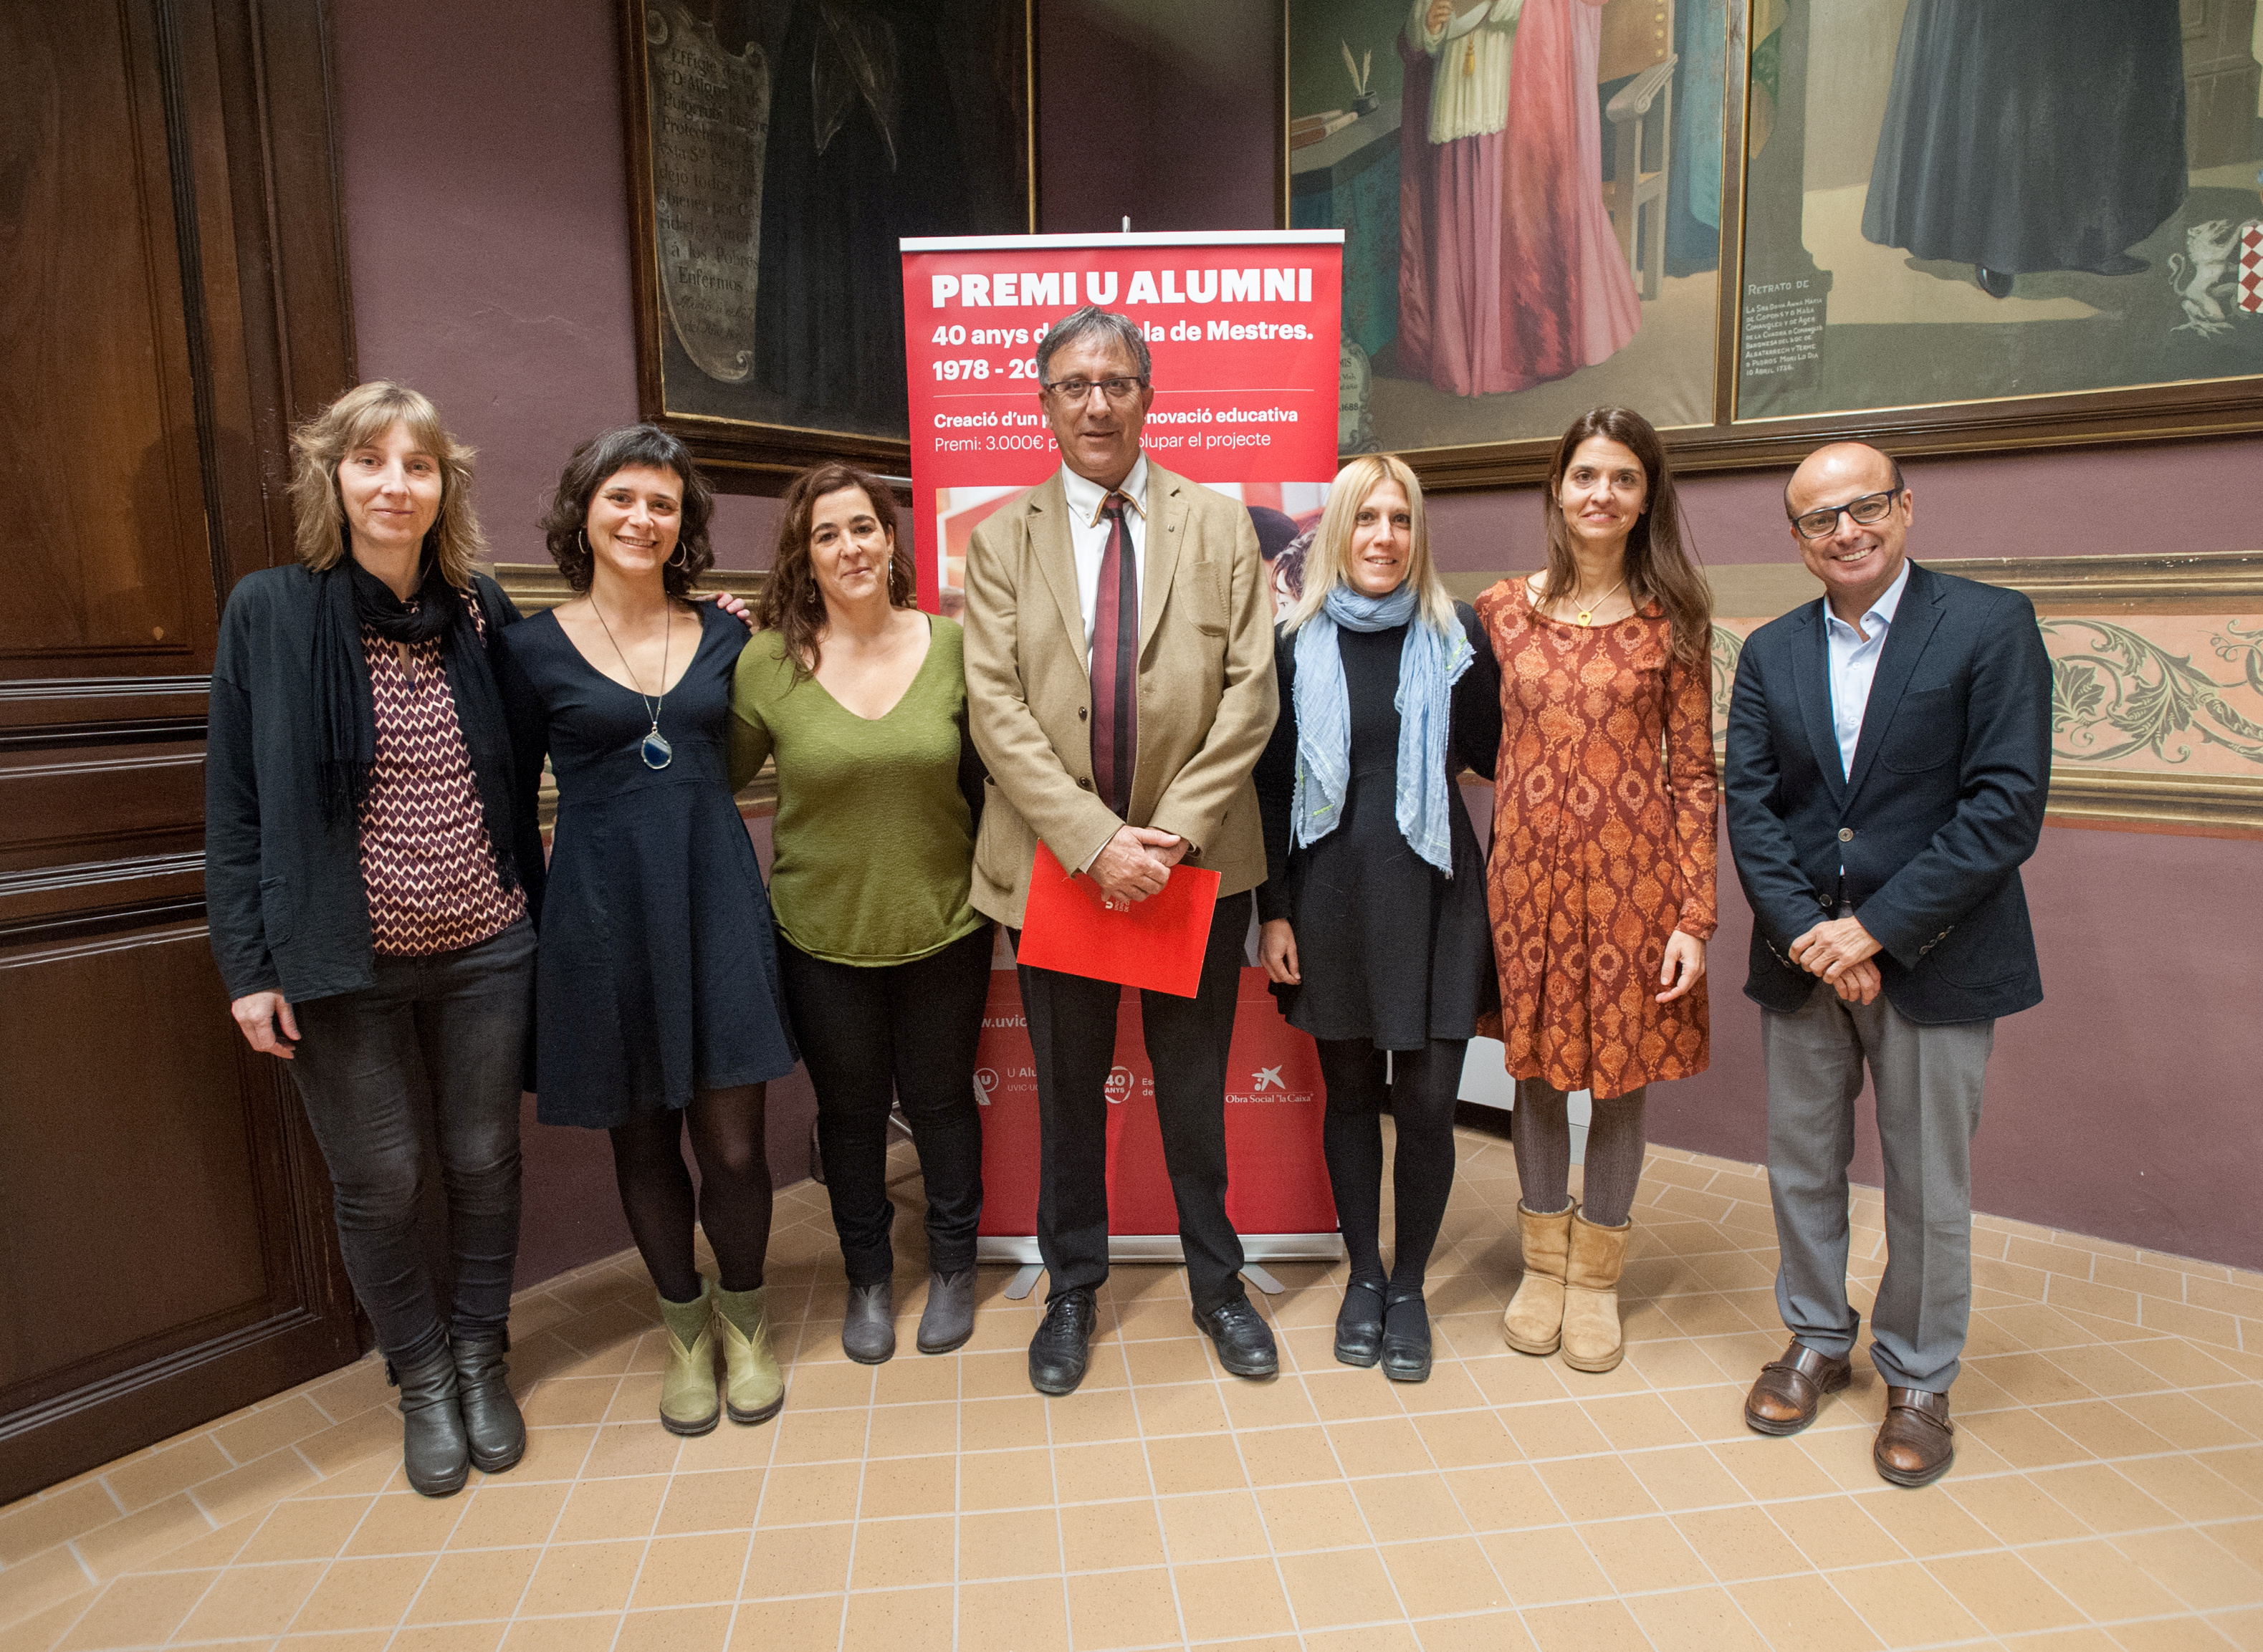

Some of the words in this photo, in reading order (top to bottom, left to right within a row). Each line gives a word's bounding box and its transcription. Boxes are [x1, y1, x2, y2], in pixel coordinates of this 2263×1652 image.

[689, 240, 707, 261] los
[715, 246, 758, 270] Pobres
[932, 272, 1077, 308] PREMI
[1086, 271, 1118, 305] U
[1126, 268, 1312, 304] ALUMNI
[932, 325, 966, 346] 40
[971, 328, 1029, 348] anys
[1170, 320, 1202, 341] de
[1207, 320, 1313, 340] Mestres.
[932, 360, 989, 380] 1978
[934, 412, 998, 428] Creació
[1215, 407, 1298, 422] educativa
[935, 437, 981, 451] Premi:
[986, 435, 1043, 451] 3.000€
[1188, 432, 1201, 447] el
[1207, 432, 1271, 449] projecte
[1008, 1068, 1015, 1077] U
[1019, 1067, 1037, 1077] Alu
[1106, 1075, 1125, 1086] 40
[1225, 1095, 1248, 1103] Obra
[1250, 1095, 1274, 1103] Social
